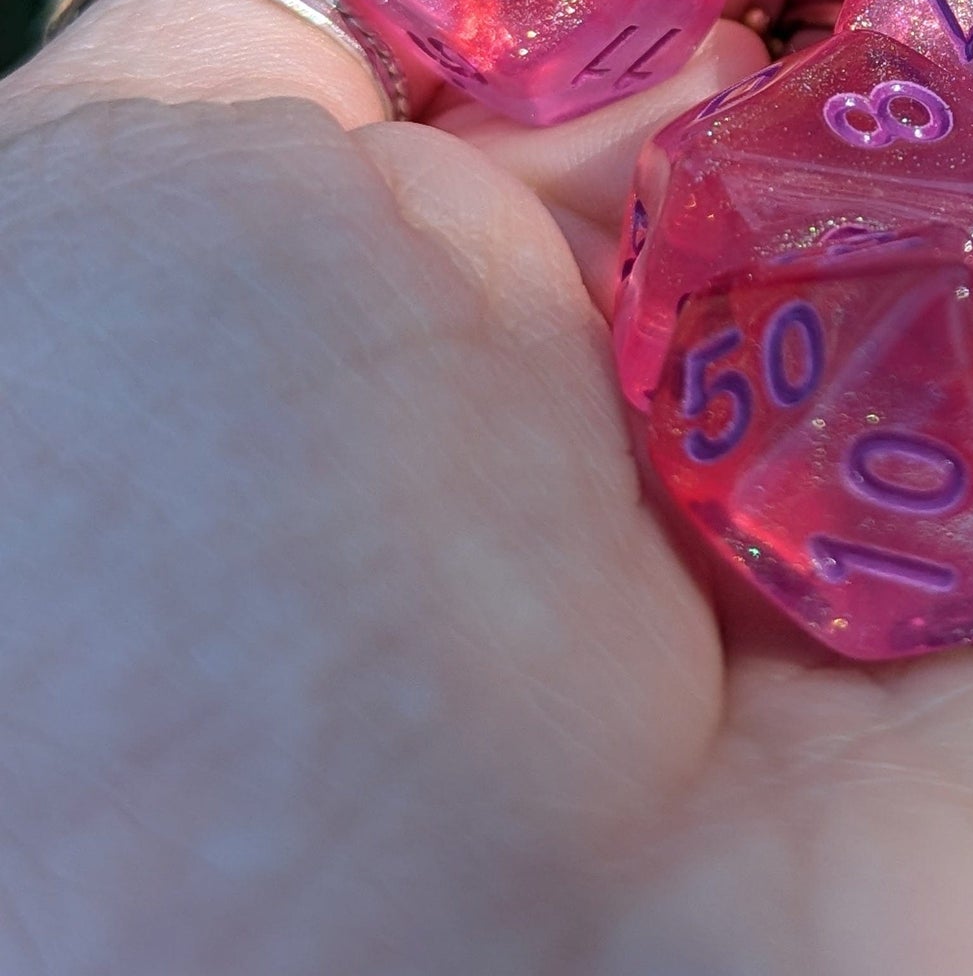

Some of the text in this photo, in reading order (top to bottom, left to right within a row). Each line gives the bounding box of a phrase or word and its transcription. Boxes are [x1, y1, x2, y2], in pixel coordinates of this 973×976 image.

[571, 25, 683, 90] 11
[822, 79, 954, 149] 8
[682, 299, 826, 464] 50
[804, 427, 970, 594] 10
